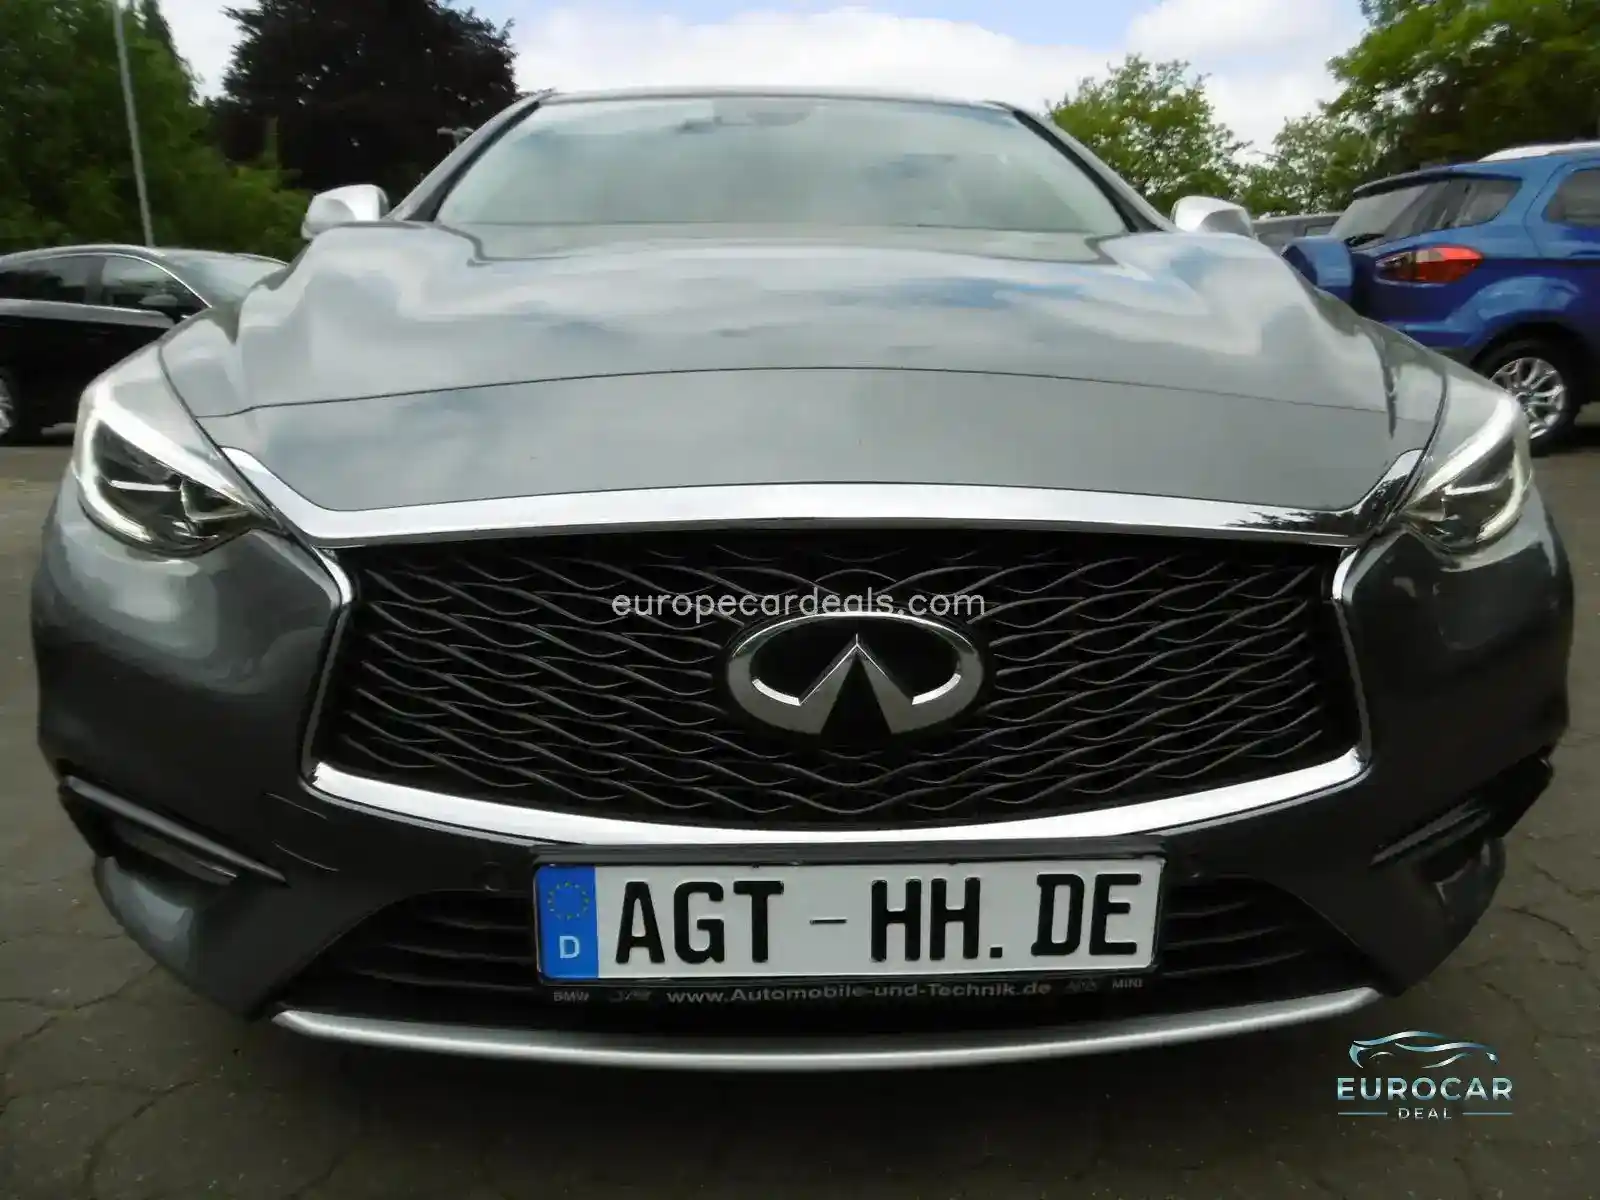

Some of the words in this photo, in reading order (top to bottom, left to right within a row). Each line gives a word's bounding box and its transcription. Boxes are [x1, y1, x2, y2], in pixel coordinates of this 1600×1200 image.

[615, 880, 785, 964] AGT
[1031, 873, 1142, 956] DE
[559, 935, 581, 959] D
[1112, 978, 1144, 990] MINI
[553, 989, 590, 1004] BMW
